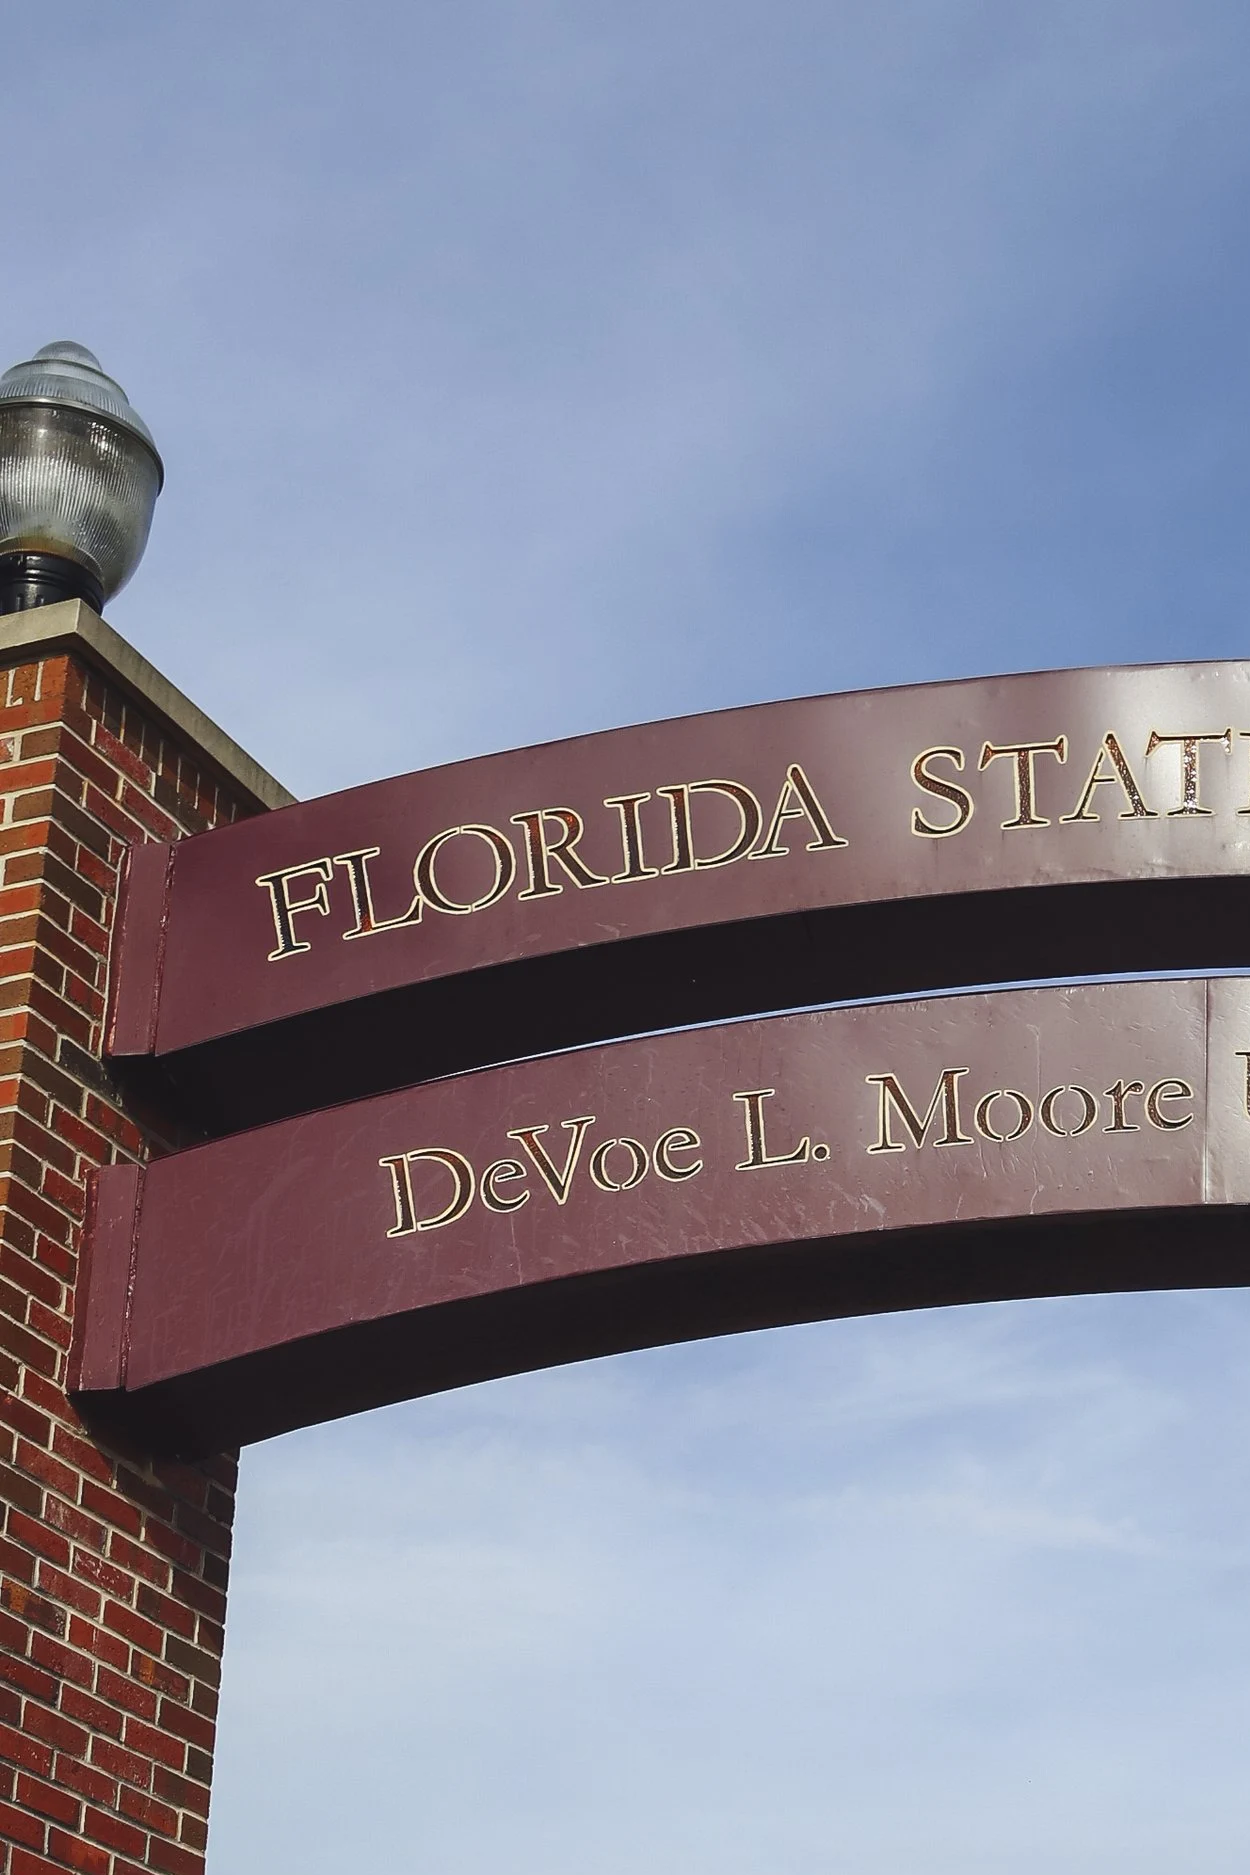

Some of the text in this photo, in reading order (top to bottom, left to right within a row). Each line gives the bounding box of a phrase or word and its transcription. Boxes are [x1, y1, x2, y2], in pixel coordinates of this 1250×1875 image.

[256, 763, 848, 961] FLORIDA
[379, 1115, 704, 1240] DeVoe
[732, 1088, 830, 1172] L.
[865, 1066, 1194, 1155] Moore
